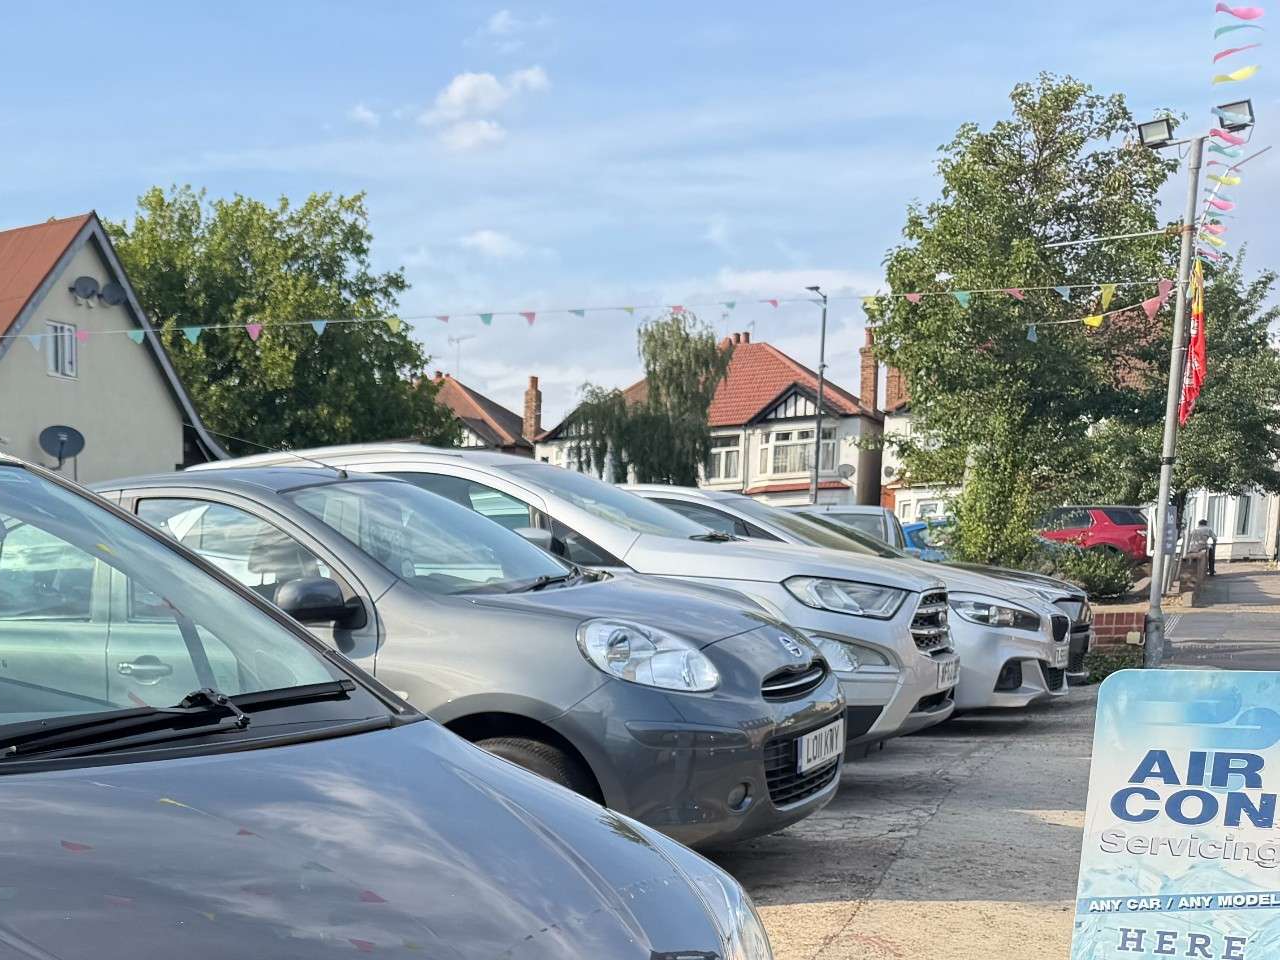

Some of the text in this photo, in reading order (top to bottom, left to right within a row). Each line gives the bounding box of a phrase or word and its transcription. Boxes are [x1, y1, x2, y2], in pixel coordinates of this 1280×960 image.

[1128, 749, 1265, 789] AIR
[1110, 786, 1277, 829] CON
[1100, 828, 1280, 868] Servicing
[1089, 899, 1124, 913] ANY
[1127, 898, 1162, 911] CAR
[1178, 895, 1213, 909] ANY
[1220, 893, 1280, 908] MODEL
[1117, 927, 1247, 960] HERE
